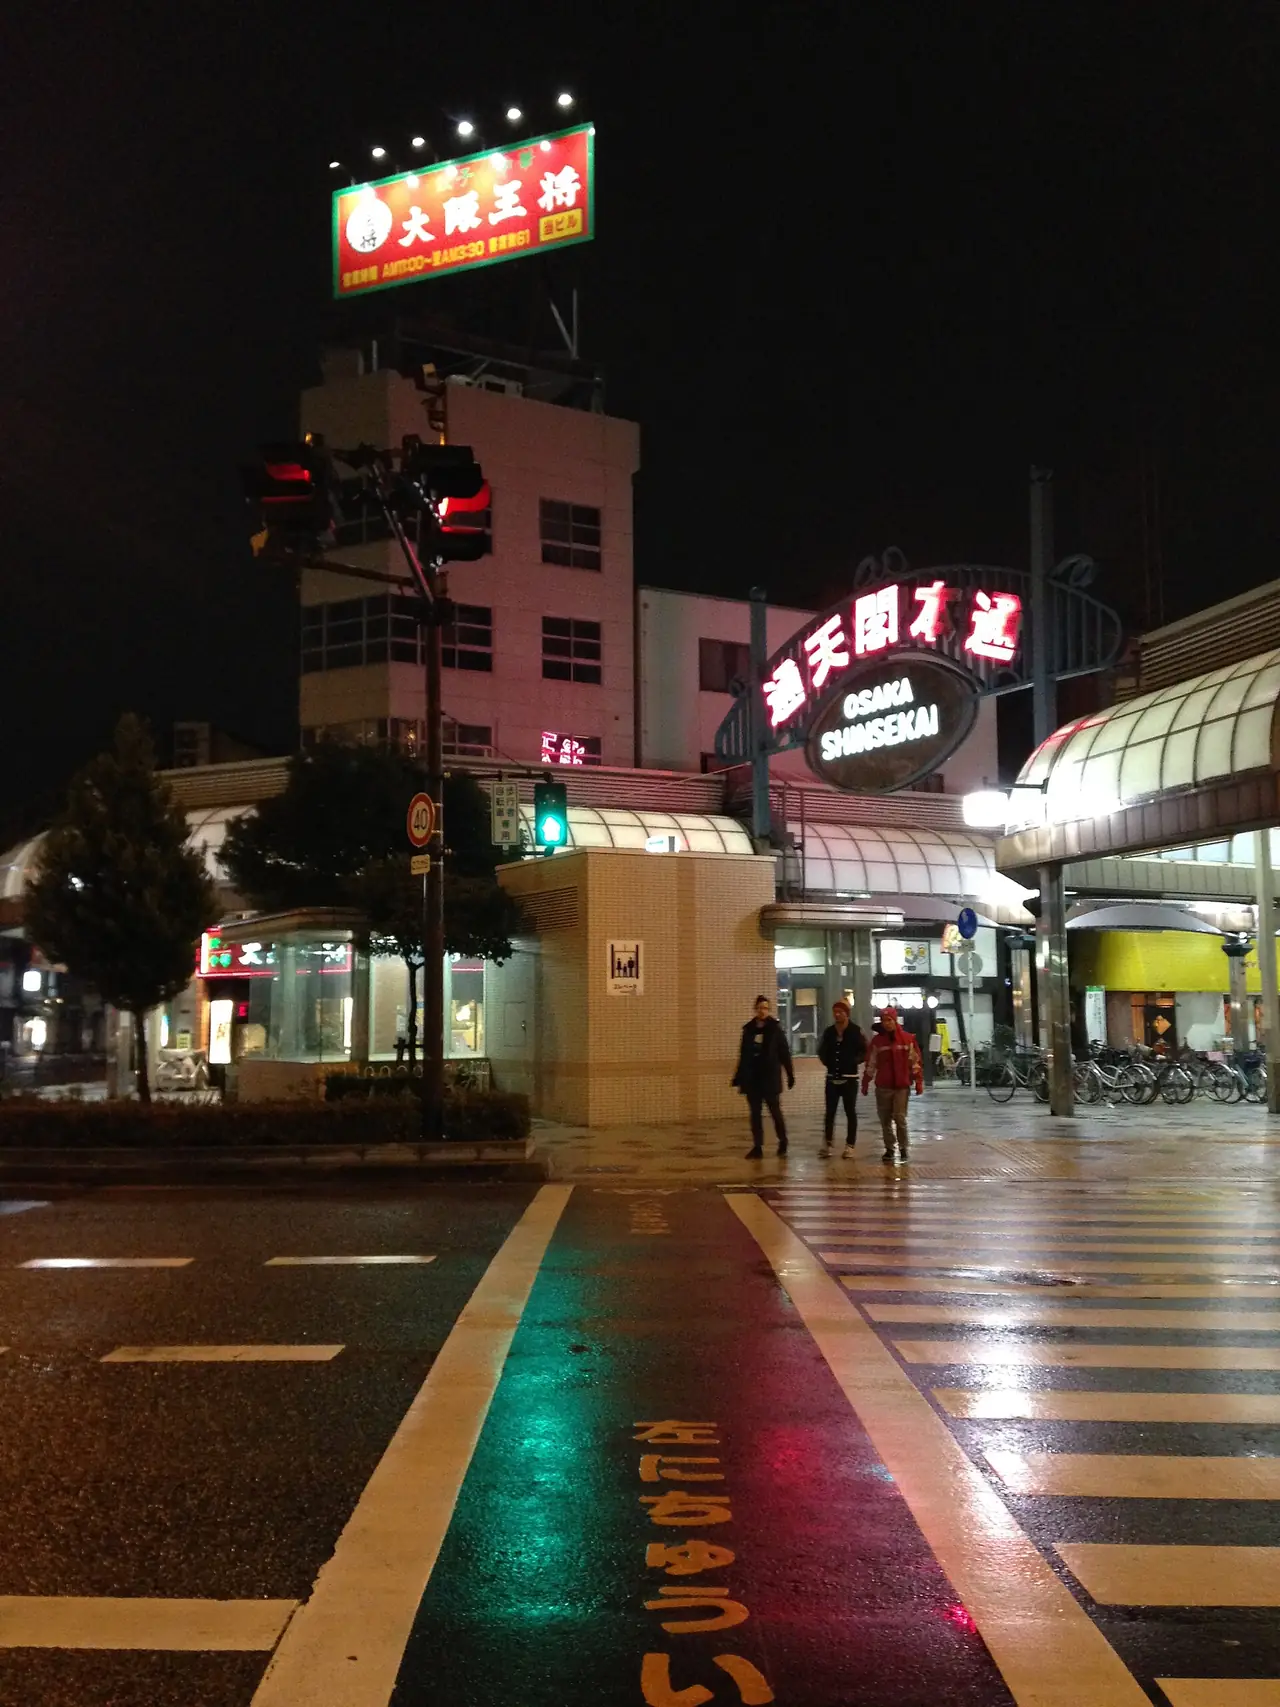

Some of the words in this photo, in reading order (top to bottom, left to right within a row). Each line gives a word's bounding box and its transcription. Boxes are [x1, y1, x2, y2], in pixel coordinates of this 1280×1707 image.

[398, 165, 581, 248] 大阪王将
[762, 581, 1021, 727] 通天閣本通
[843, 677, 914, 720] OSAKA
[821, 703, 940, 761] SHINSEKAI
[413, 807, 428, 830] 40
